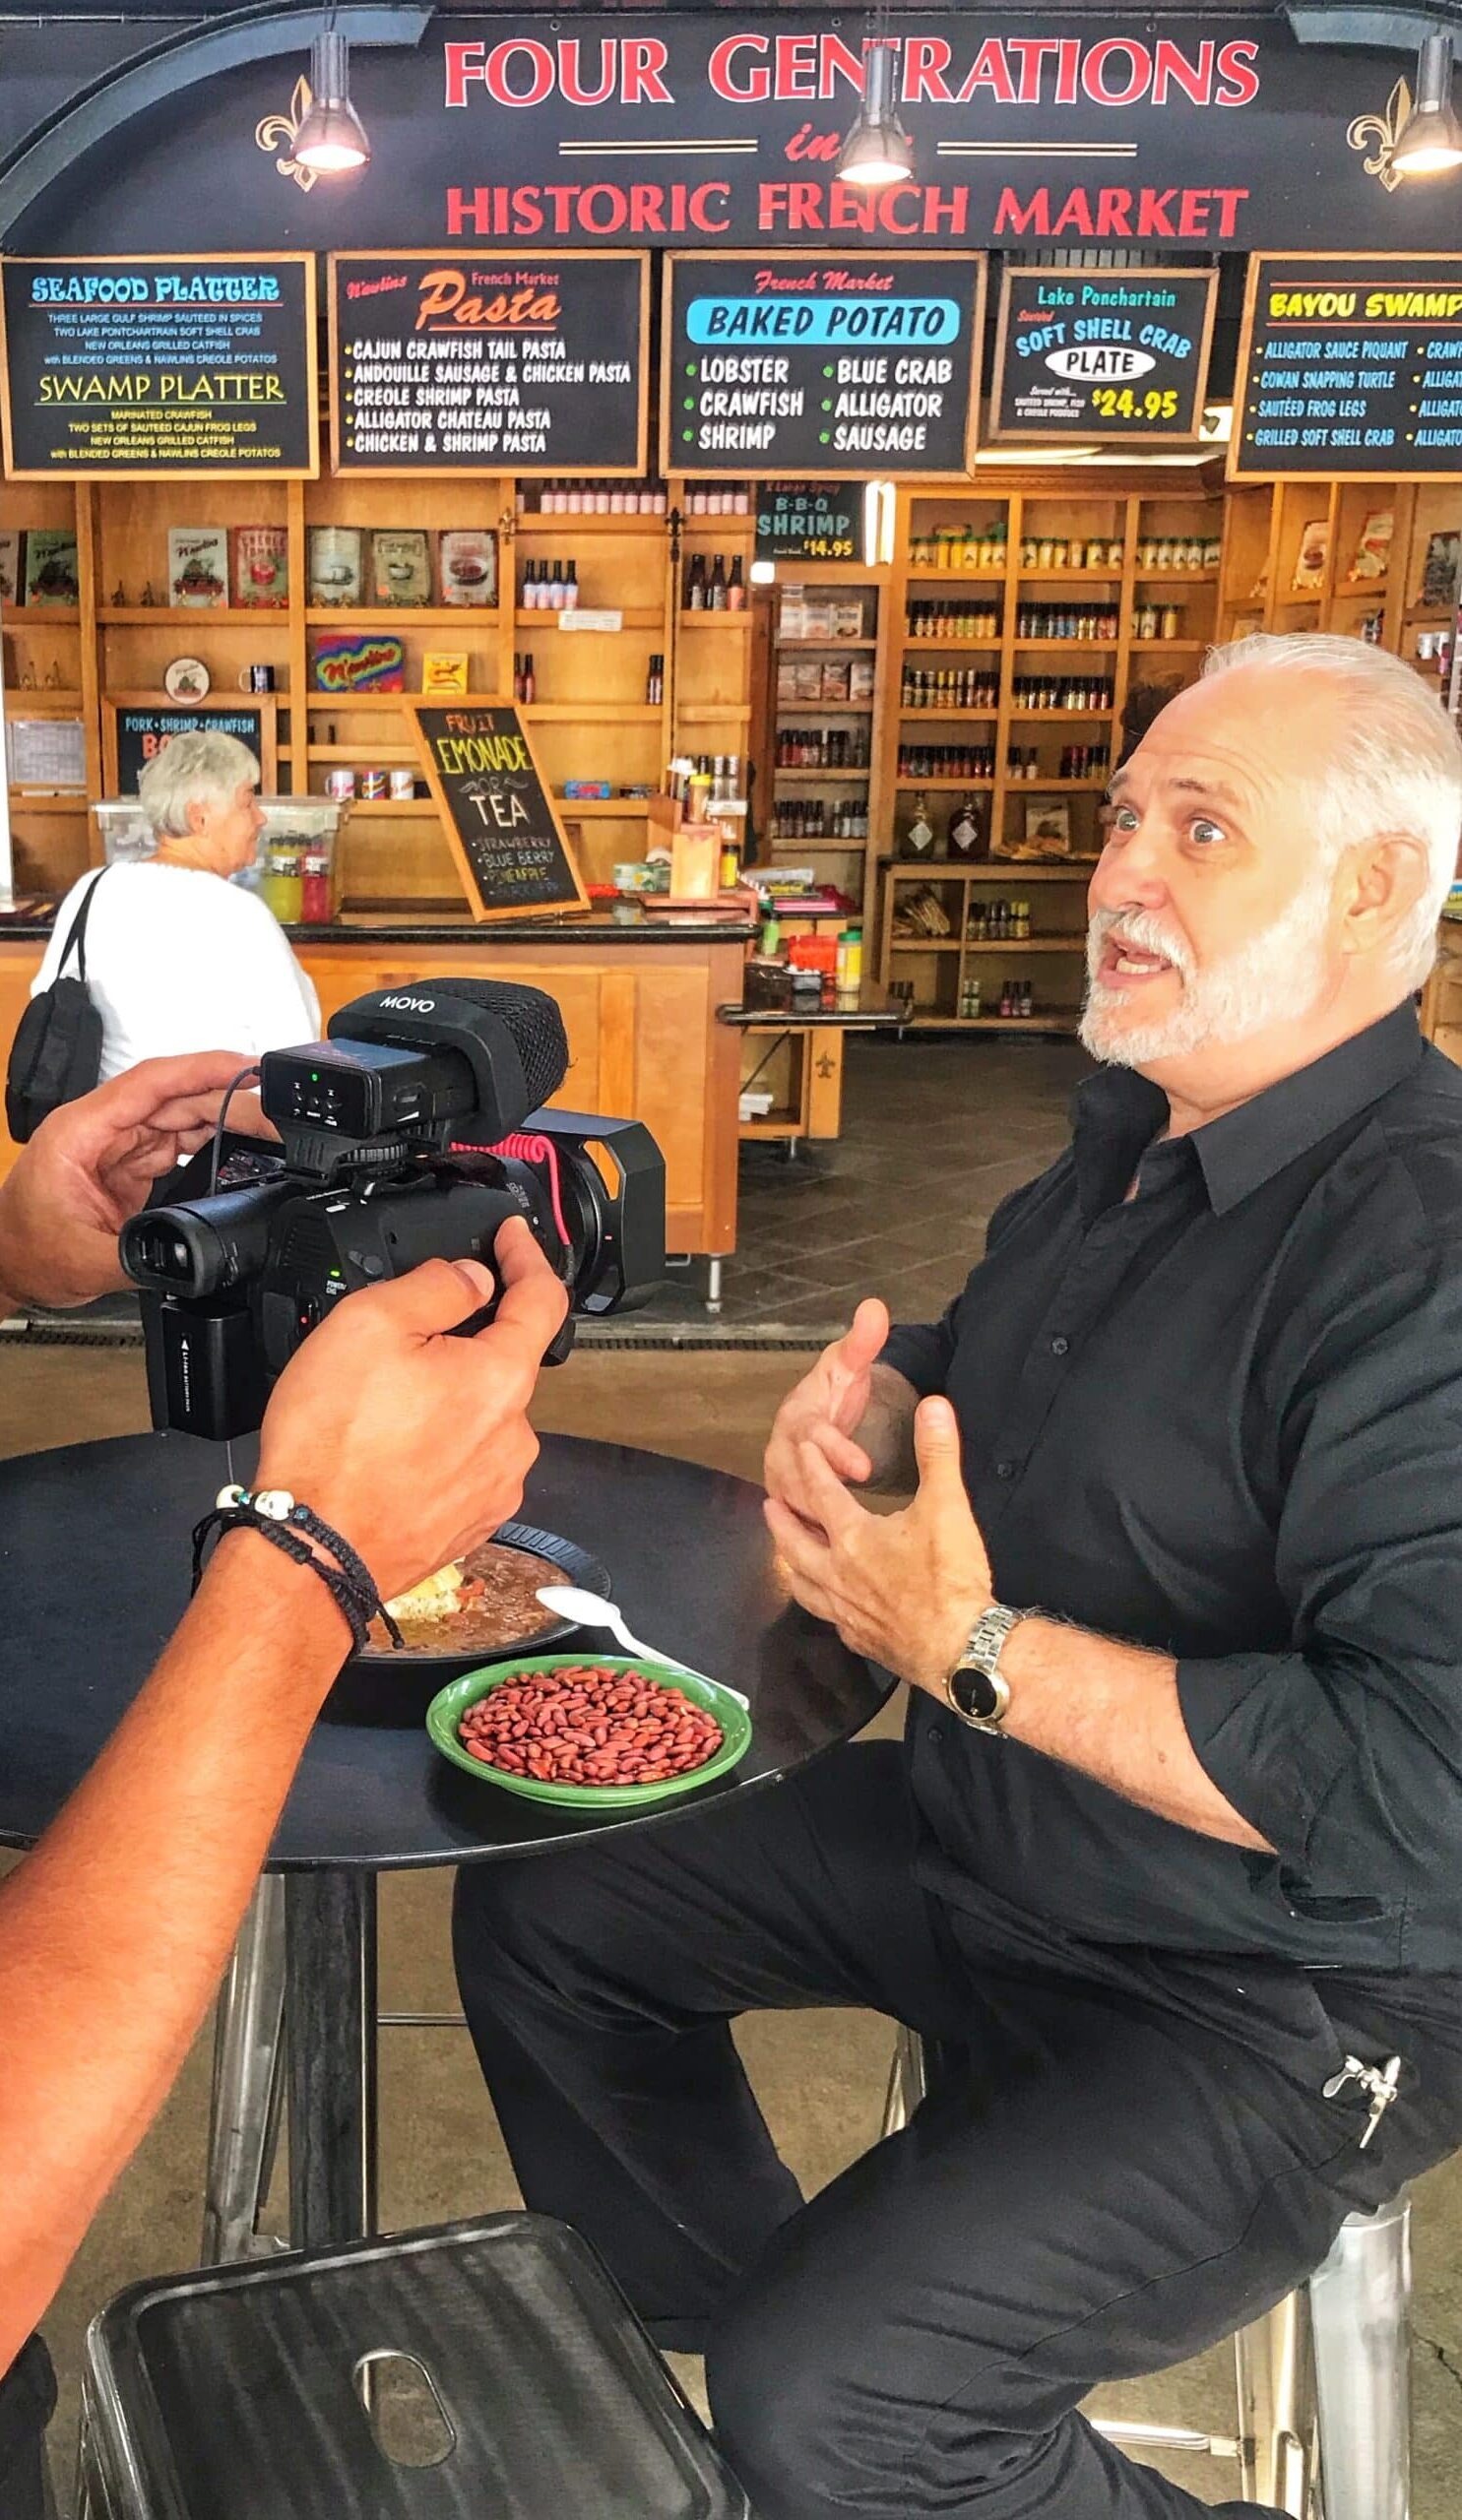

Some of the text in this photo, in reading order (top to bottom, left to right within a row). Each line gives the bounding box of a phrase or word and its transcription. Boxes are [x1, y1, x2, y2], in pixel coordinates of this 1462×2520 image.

[444, 33, 1259, 107] FOUR GENRATIONS
[785, 123, 841, 160] in
[446, 182, 1249, 237] HISTORIC FRENCH MARKET
[472, 271, 560, 285] French Market
[754, 269, 894, 294] French Market
[32, 276, 281, 302] SEAFOOD PLATTER
[1038, 285, 1074, 306] Lake
[414, 268, 562, 331] Pasta
[1269, 292, 1462, 318] BAYOU SWAMP
[48, 313, 78, 323] THREE
[80, 313, 110, 323] LARGE
[112, 313, 136, 323] GULF
[138, 313, 172, 323] SHRIMP
[219, 313, 227, 323] IN
[229, 313, 262, 323] SPICES
[707, 306, 945, 338] BAKED POTATO
[54, 327, 260, 337] TWO LAKE PONTCHARTRAIN SOFT SHELL CRAB
[1015, 317, 1192, 358] SOFT SHELL CRAB
[85, 341, 230, 350] NEW ORLEANS GRILLED CATFISH
[352, 340, 566, 359] CAJUN CRAWFISH TAIL PASTA
[1264, 341, 1409, 361] ALLIGATOR SAUCE PIQUANT
[62, 354, 104, 364] BLENDED
[106, 354, 143, 364] GREENS
[1066, 350, 1135, 375] PLATE
[353, 363, 631, 383] ANDOUILLE SAUSAGE & CHICKEN PASTA
[700, 357, 790, 383] LOBSTER
[837, 358, 953, 385] BLUE CRAB
[1260, 370, 1396, 390] COWAN SNAPPING TURTLE
[39, 375, 285, 402] SWAMP PLATTER
[353, 388, 520, 407] CREOLE SHRIMP PASTA
[699, 391, 804, 417] CRAWFISH
[835, 393, 943, 417] ALLIGATOR
[1091, 388, 1178, 420] $24.95
[1306, 400, 1337, 417] FROG
[1339, 400, 1367, 417] LEGS
[164, 410, 213, 419] CRAWFISH
[354, 410, 550, 430] ALLIGATOR CHATEAU PASTA
[68, 423, 90, 433] TWO
[91, 423, 114, 433] SETS
[698, 423, 776, 450] SHRIMP
[1254, 428, 1395, 447] GRILLED SOFT SHELL CRAB
[91, 436, 235, 446] NEW ORLEANS GRILLED CATFISH
[354, 434, 546, 453] CHICKEN & SHRIMP PASTA
[833, 425, 926, 452] SAUSAGE
[775, 496, 829, 513] B-B-Q
[757, 514, 851, 536] SHRIMP
[803, 539, 854, 557] $14.95
[125, 717, 255, 733] PORK SHRIMP CRAWFISH
[446, 713, 494, 735] FRUIT
[469, 794, 532, 828] TEA
[481, 850, 556, 869] BLUE BERRY
[379, 995, 435, 1013] MOVO
